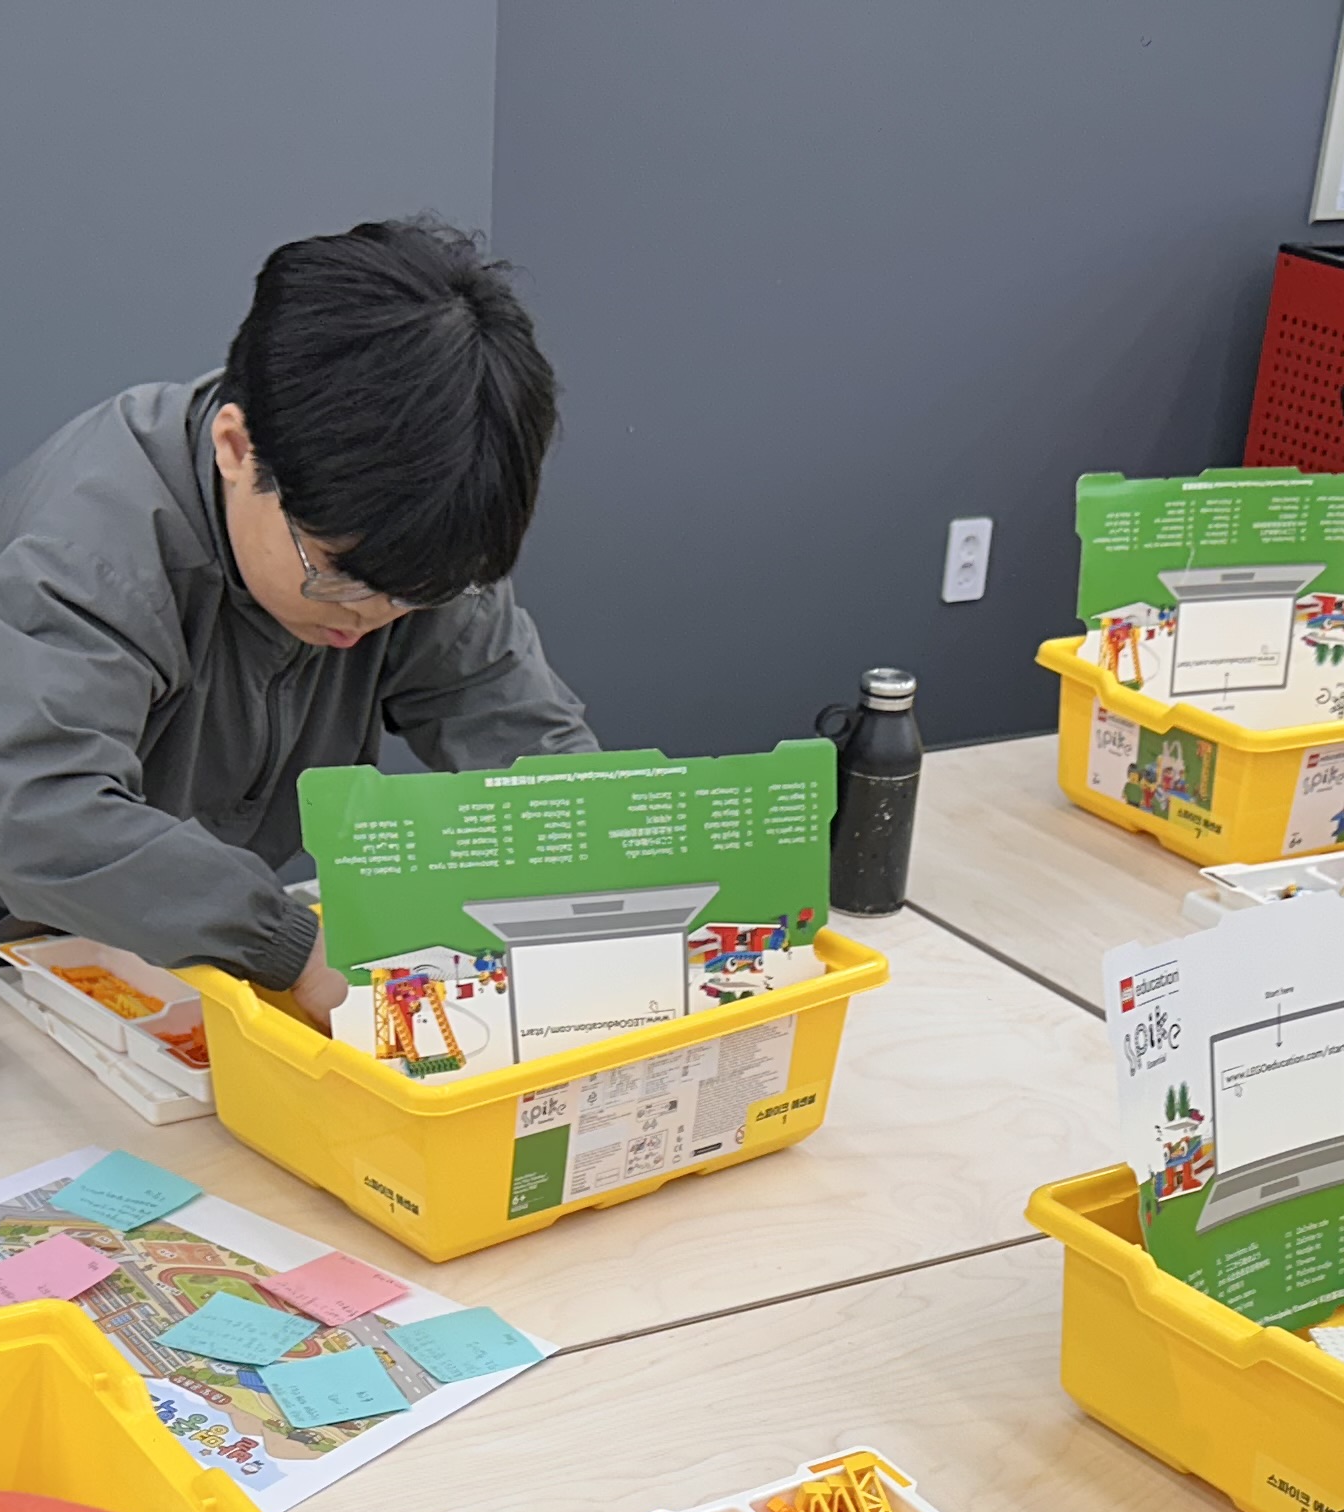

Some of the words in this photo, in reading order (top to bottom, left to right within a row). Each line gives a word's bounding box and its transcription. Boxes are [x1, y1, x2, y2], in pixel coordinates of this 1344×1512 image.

[1135, 970, 1180, 997] education
[1123, 1005, 1182, 1078] spike
[521, 1098, 567, 1128] spike
[149, 1395, 260, 1465] 발명중학
[1266, 1474, 1311, 1508] 스파이크
